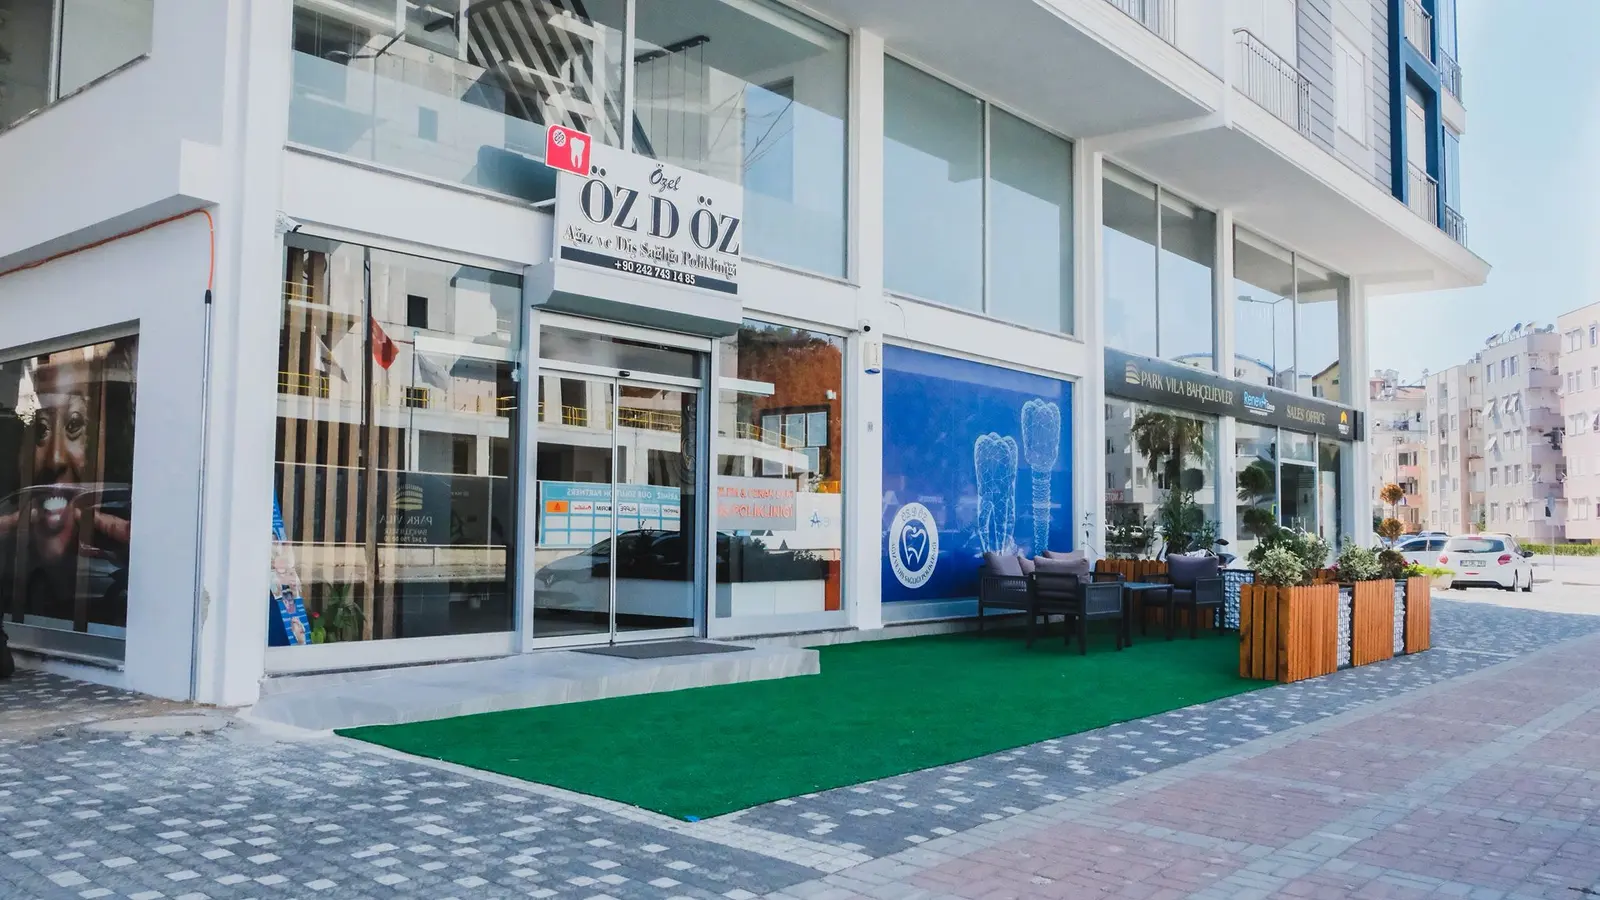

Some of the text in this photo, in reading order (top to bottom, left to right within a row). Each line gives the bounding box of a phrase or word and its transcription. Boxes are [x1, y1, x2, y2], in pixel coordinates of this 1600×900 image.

[649, 163, 682, 193] Özel
[580, 165, 740, 255] ÖZ D ÖZ
[563, 224, 737, 280] Ağız ve Diş Sağlığı Polikliniği
[614, 260, 696, 285] +90 242 743 14 85
[1141, 370, 1164, 391] PARK
[1286, 404, 1304, 421] SALES
[1305, 409, 1326, 426] OFFICE
